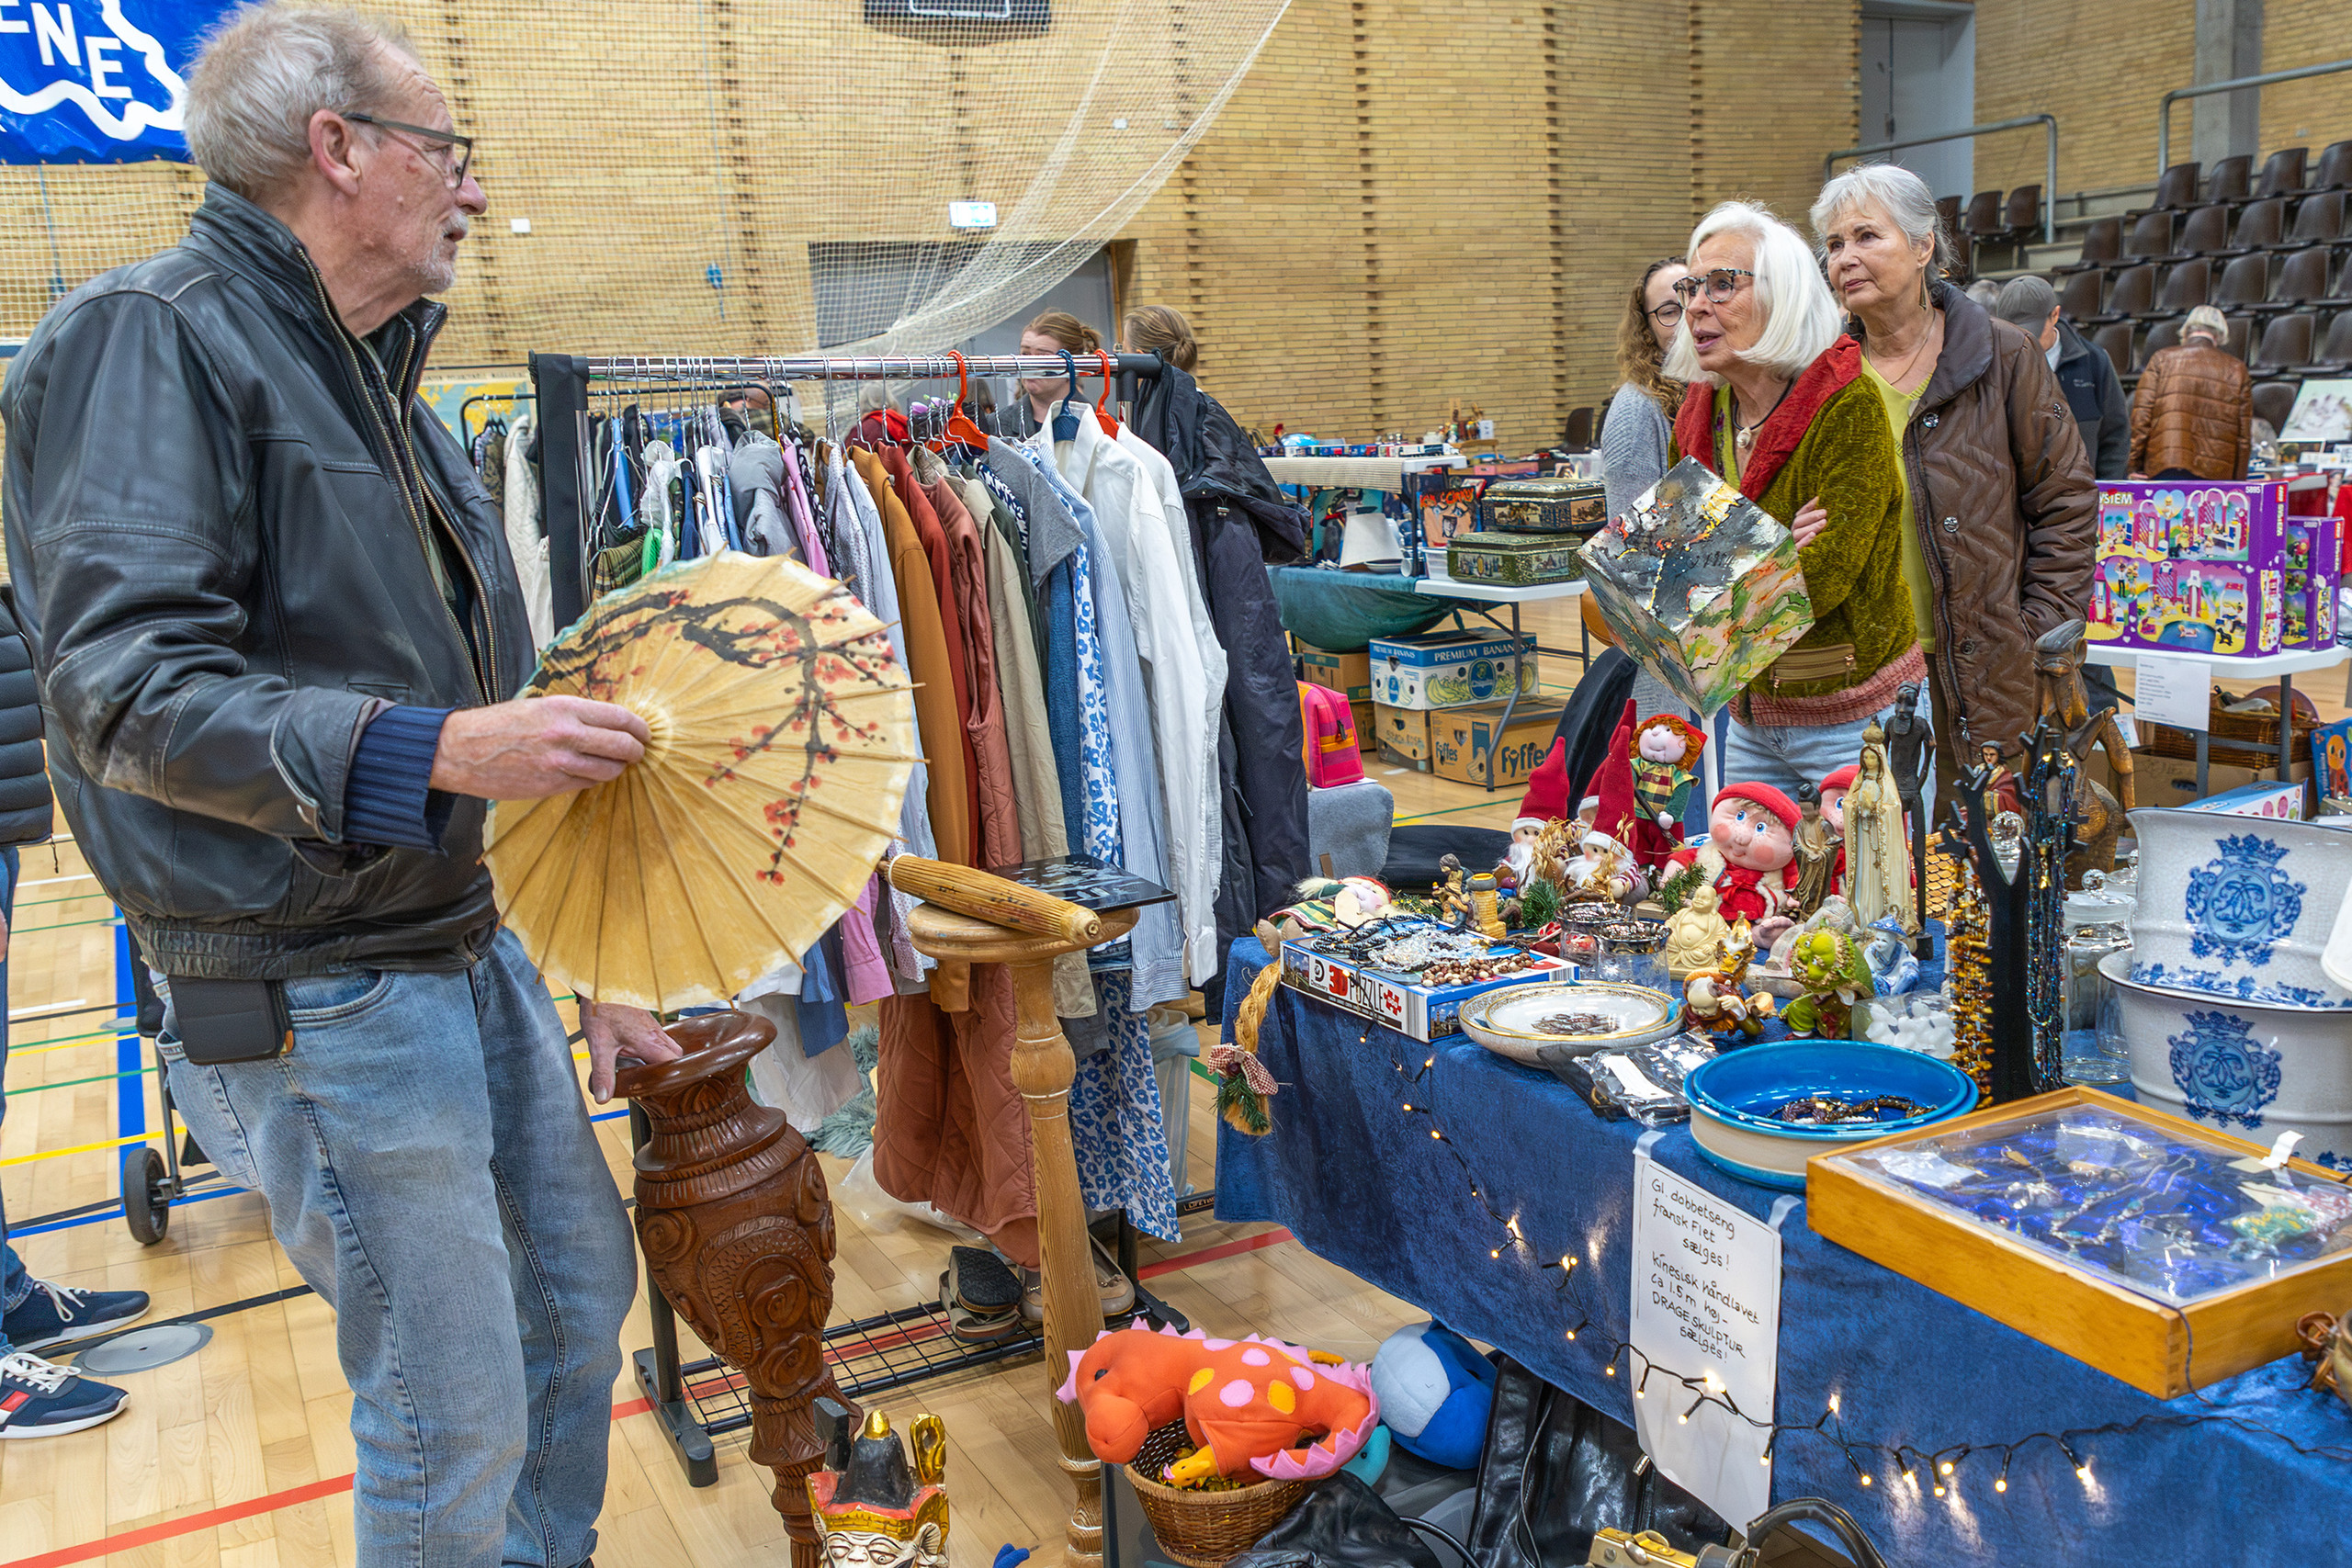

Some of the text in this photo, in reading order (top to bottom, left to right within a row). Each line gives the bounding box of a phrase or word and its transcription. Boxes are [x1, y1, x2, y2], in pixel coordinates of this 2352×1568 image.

[1434, 643, 1525, 662] PREMIUM BANANS
[1350, 972, 1385, 1014] PUZZLE
[1653, 1198, 1689, 1229] fransk
[1670, 1190, 1735, 1240] dobbetseng
[1652, 1291, 1690, 1323] DRAGE
[1702, 1280, 1760, 1325] håndlavet
